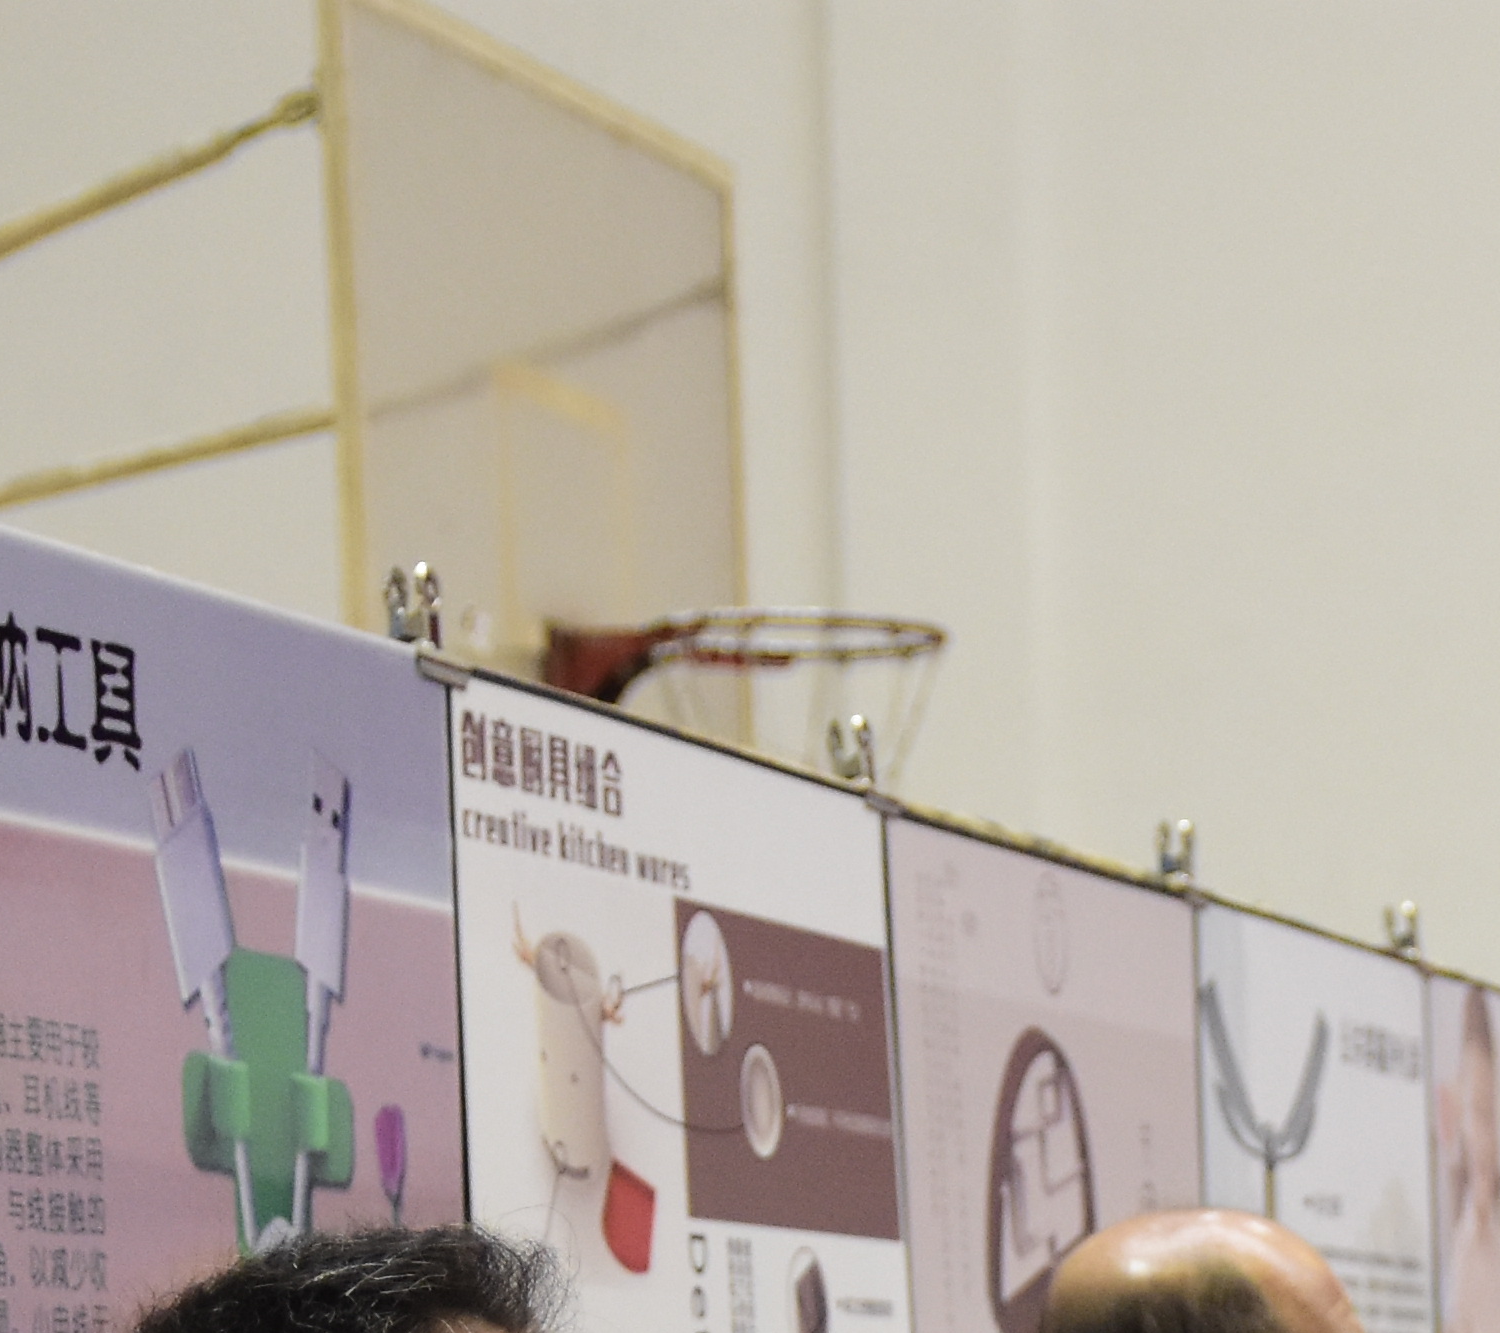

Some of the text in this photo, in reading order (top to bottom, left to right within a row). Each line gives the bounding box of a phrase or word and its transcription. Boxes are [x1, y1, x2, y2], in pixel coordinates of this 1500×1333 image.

[462, 807, 691, 891] creative kitchen wares
